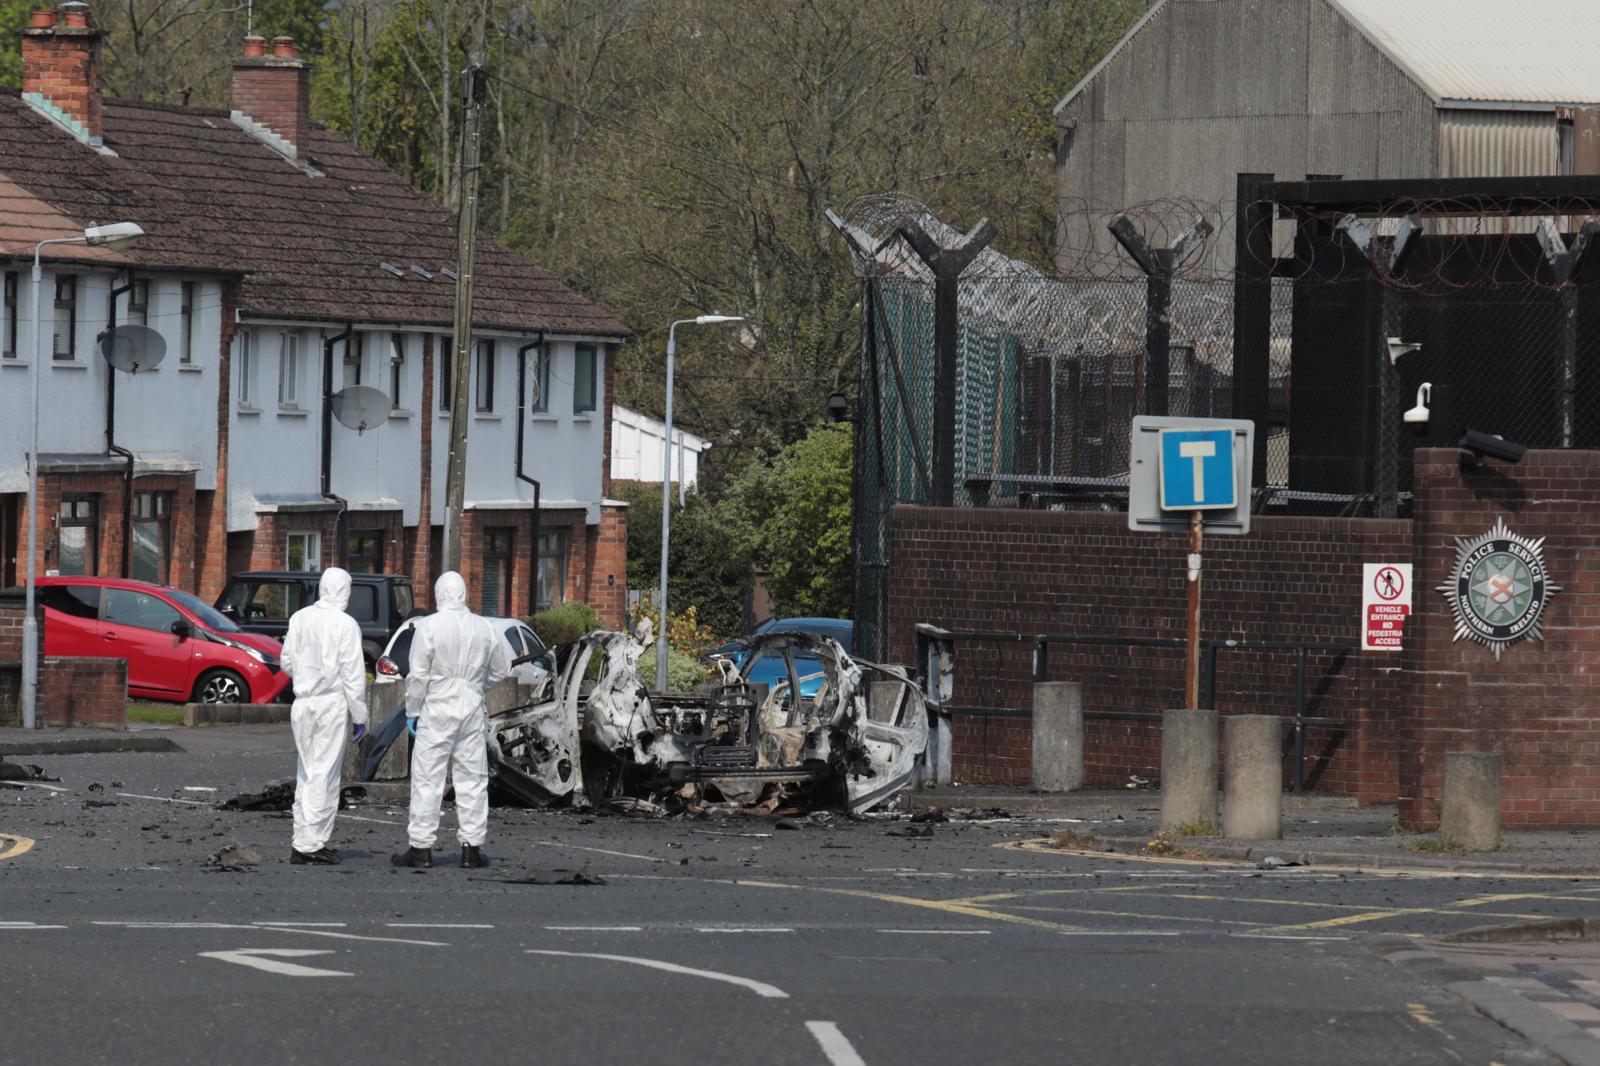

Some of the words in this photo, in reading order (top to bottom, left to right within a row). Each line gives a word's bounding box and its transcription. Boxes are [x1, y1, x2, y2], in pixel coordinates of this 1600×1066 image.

[1461, 543, 1494, 579] POLICE
[1508, 543, 1541, 582] SERVICE
[1460, 594, 1494, 634] NORTHERN
[1509, 600, 1539, 633] IRELAND
